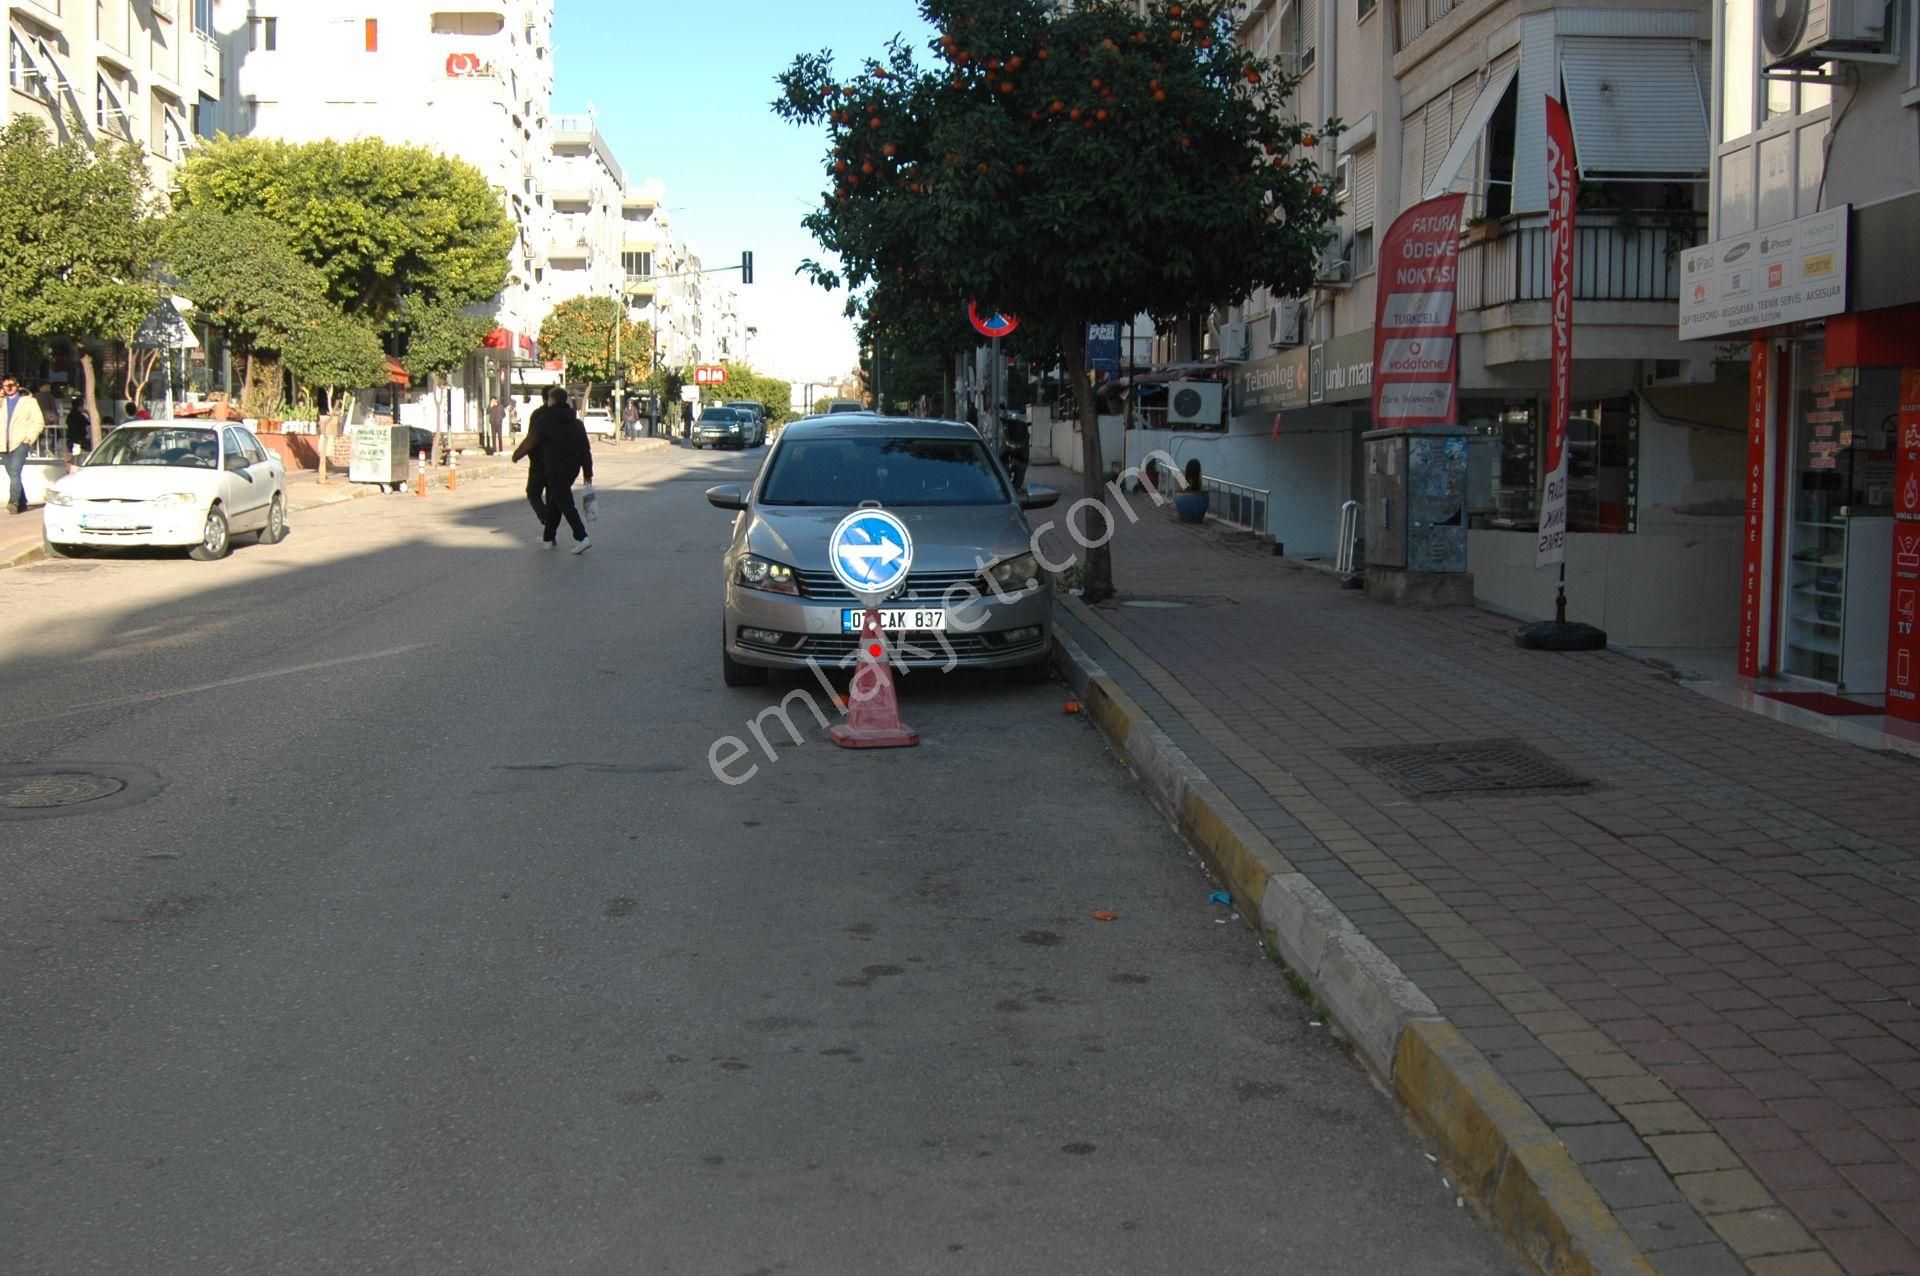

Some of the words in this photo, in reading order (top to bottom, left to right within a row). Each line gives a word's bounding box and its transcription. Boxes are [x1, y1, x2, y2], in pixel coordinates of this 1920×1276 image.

[1412, 214, 1457, 233] FATURA
[1402, 239, 1456, 259] ÖDEME
[1770, 237, 1793, 250] iPhone
[1696, 255, 1714, 271] iPad
[1396, 265, 1456, 285] NOKTASI
[1805, 285, 1841, 302] AKSESUAR
[1394, 312, 1440, 325] TURKCELL
[1389, 358, 1444, 370] vodafone
[1244, 363, 1295, 393] Teknolog
[1382, 395, 1400, 404] Türk
[1754, 353, 1763, 446] FATURA
[1750, 464, 1760, 543] ÖDEME
[880, 612, 906, 628] CAK
[915, 611, 943, 628] 837
[1898, 621, 1912, 634] TV
